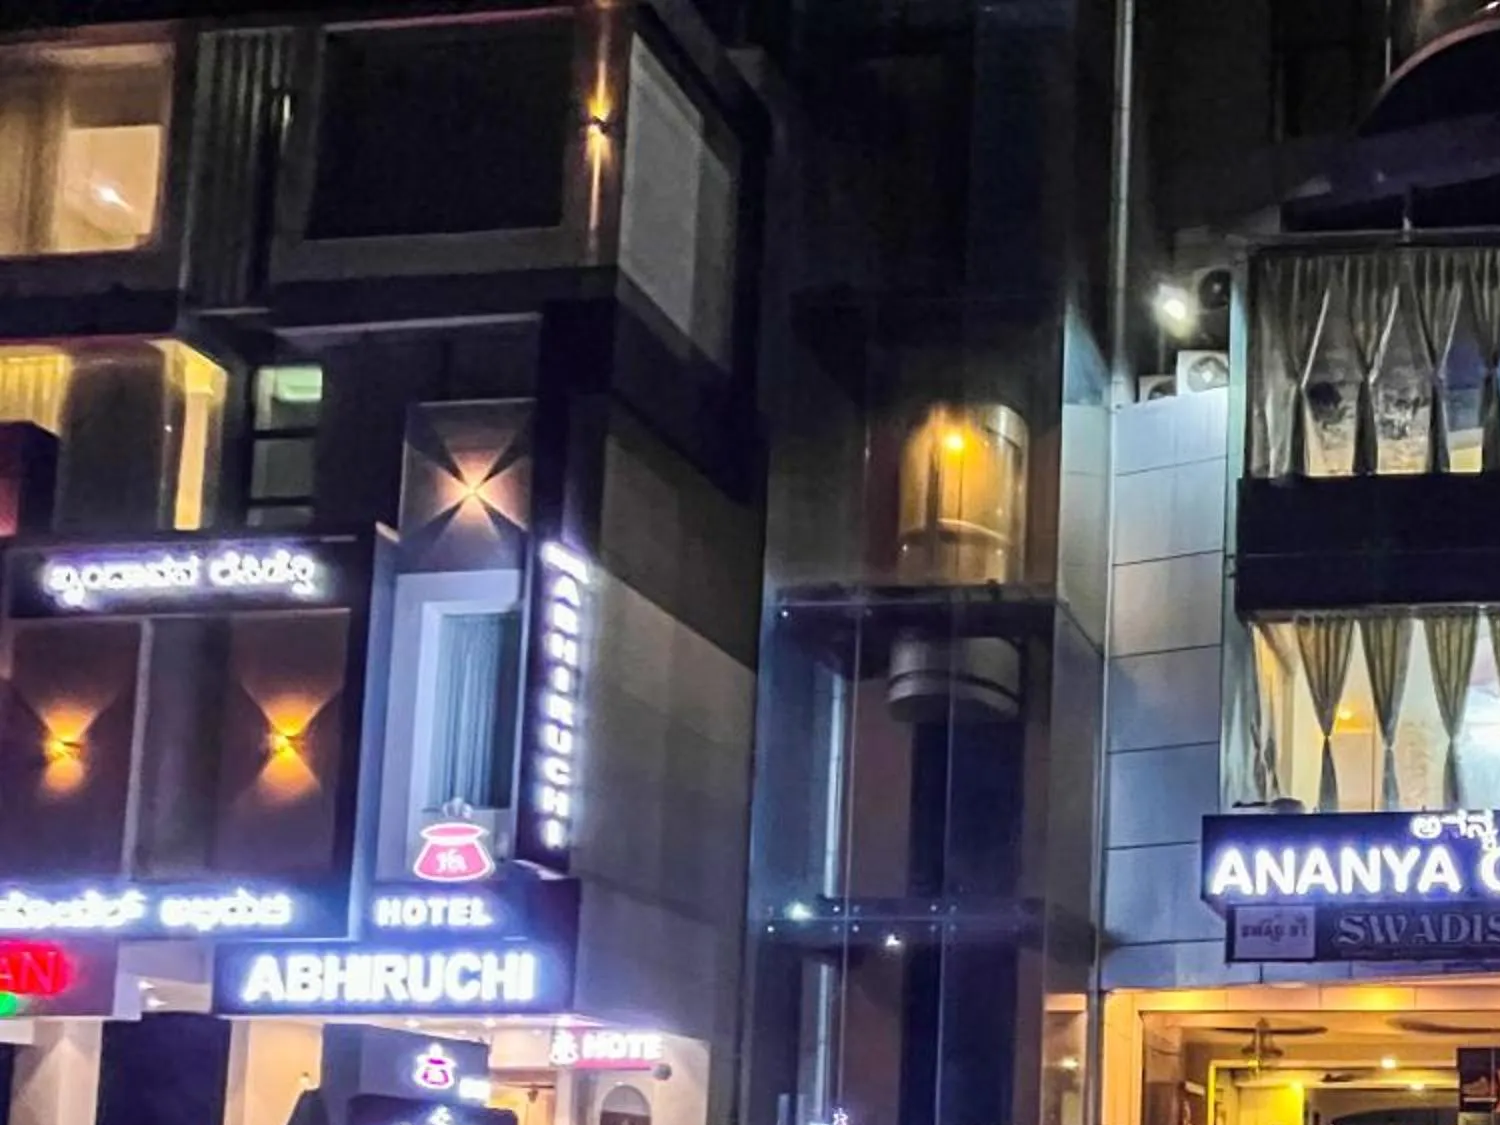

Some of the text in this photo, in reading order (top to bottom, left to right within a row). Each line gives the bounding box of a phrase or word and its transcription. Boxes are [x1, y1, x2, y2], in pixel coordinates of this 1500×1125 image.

[1212, 846, 1462, 895] ANANYA
[376, 897, 493, 926] HOTEL
[242, 953, 536, 1001] ABHIRUCHI
